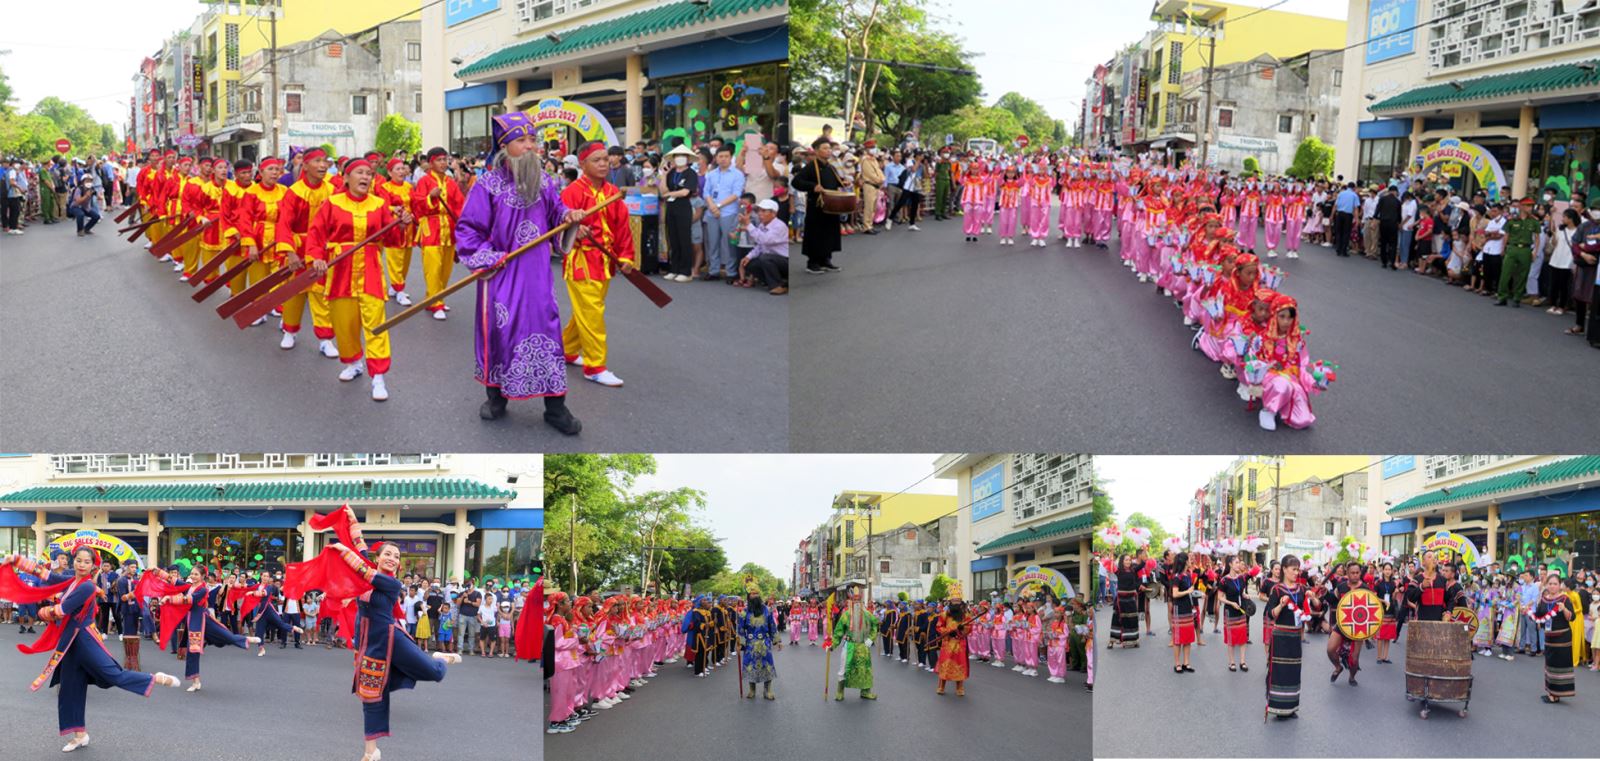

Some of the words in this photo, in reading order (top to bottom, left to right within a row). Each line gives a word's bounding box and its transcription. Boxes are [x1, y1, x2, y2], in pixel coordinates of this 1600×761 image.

[537, 110, 557, 122] SALES
[560, 110, 576, 123] 2022
[1437, 149, 1453, 157] SALES
[1455, 150, 1471, 162] 2022
[75, 538, 93, 546] SALES
[95, 539, 112, 549] 2022
